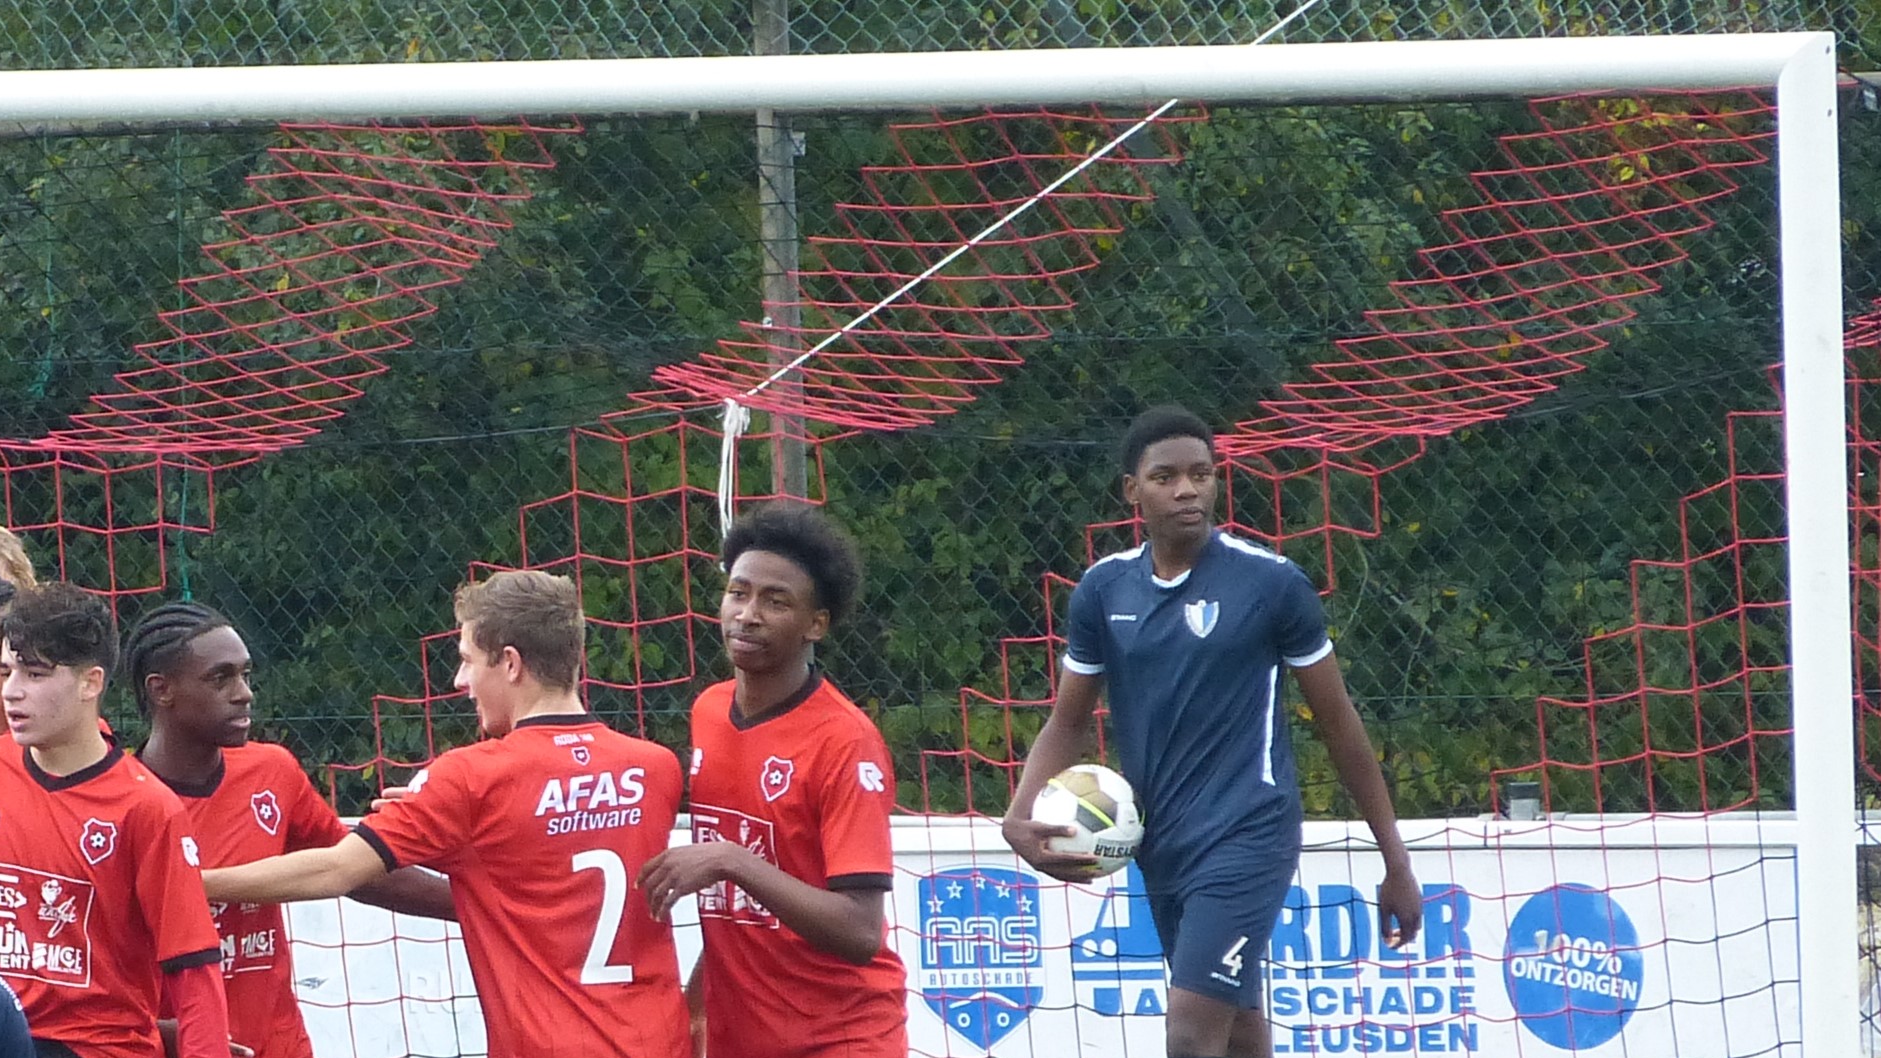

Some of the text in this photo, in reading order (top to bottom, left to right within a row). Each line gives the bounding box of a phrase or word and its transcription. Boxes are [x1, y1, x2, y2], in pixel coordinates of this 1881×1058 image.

[535, 768, 645, 816] AFAS
[547, 807, 642, 835] software
[572, 849, 633, 985] 2
[926, 916, 1038, 965] AAS
[1222, 936, 1249, 977] 4
[1534, 929, 1623, 974] 100%
[930, 972, 1034, 985] AUTOSCHADE
[1511, 957, 1638, 1001] ONTZORGEN
